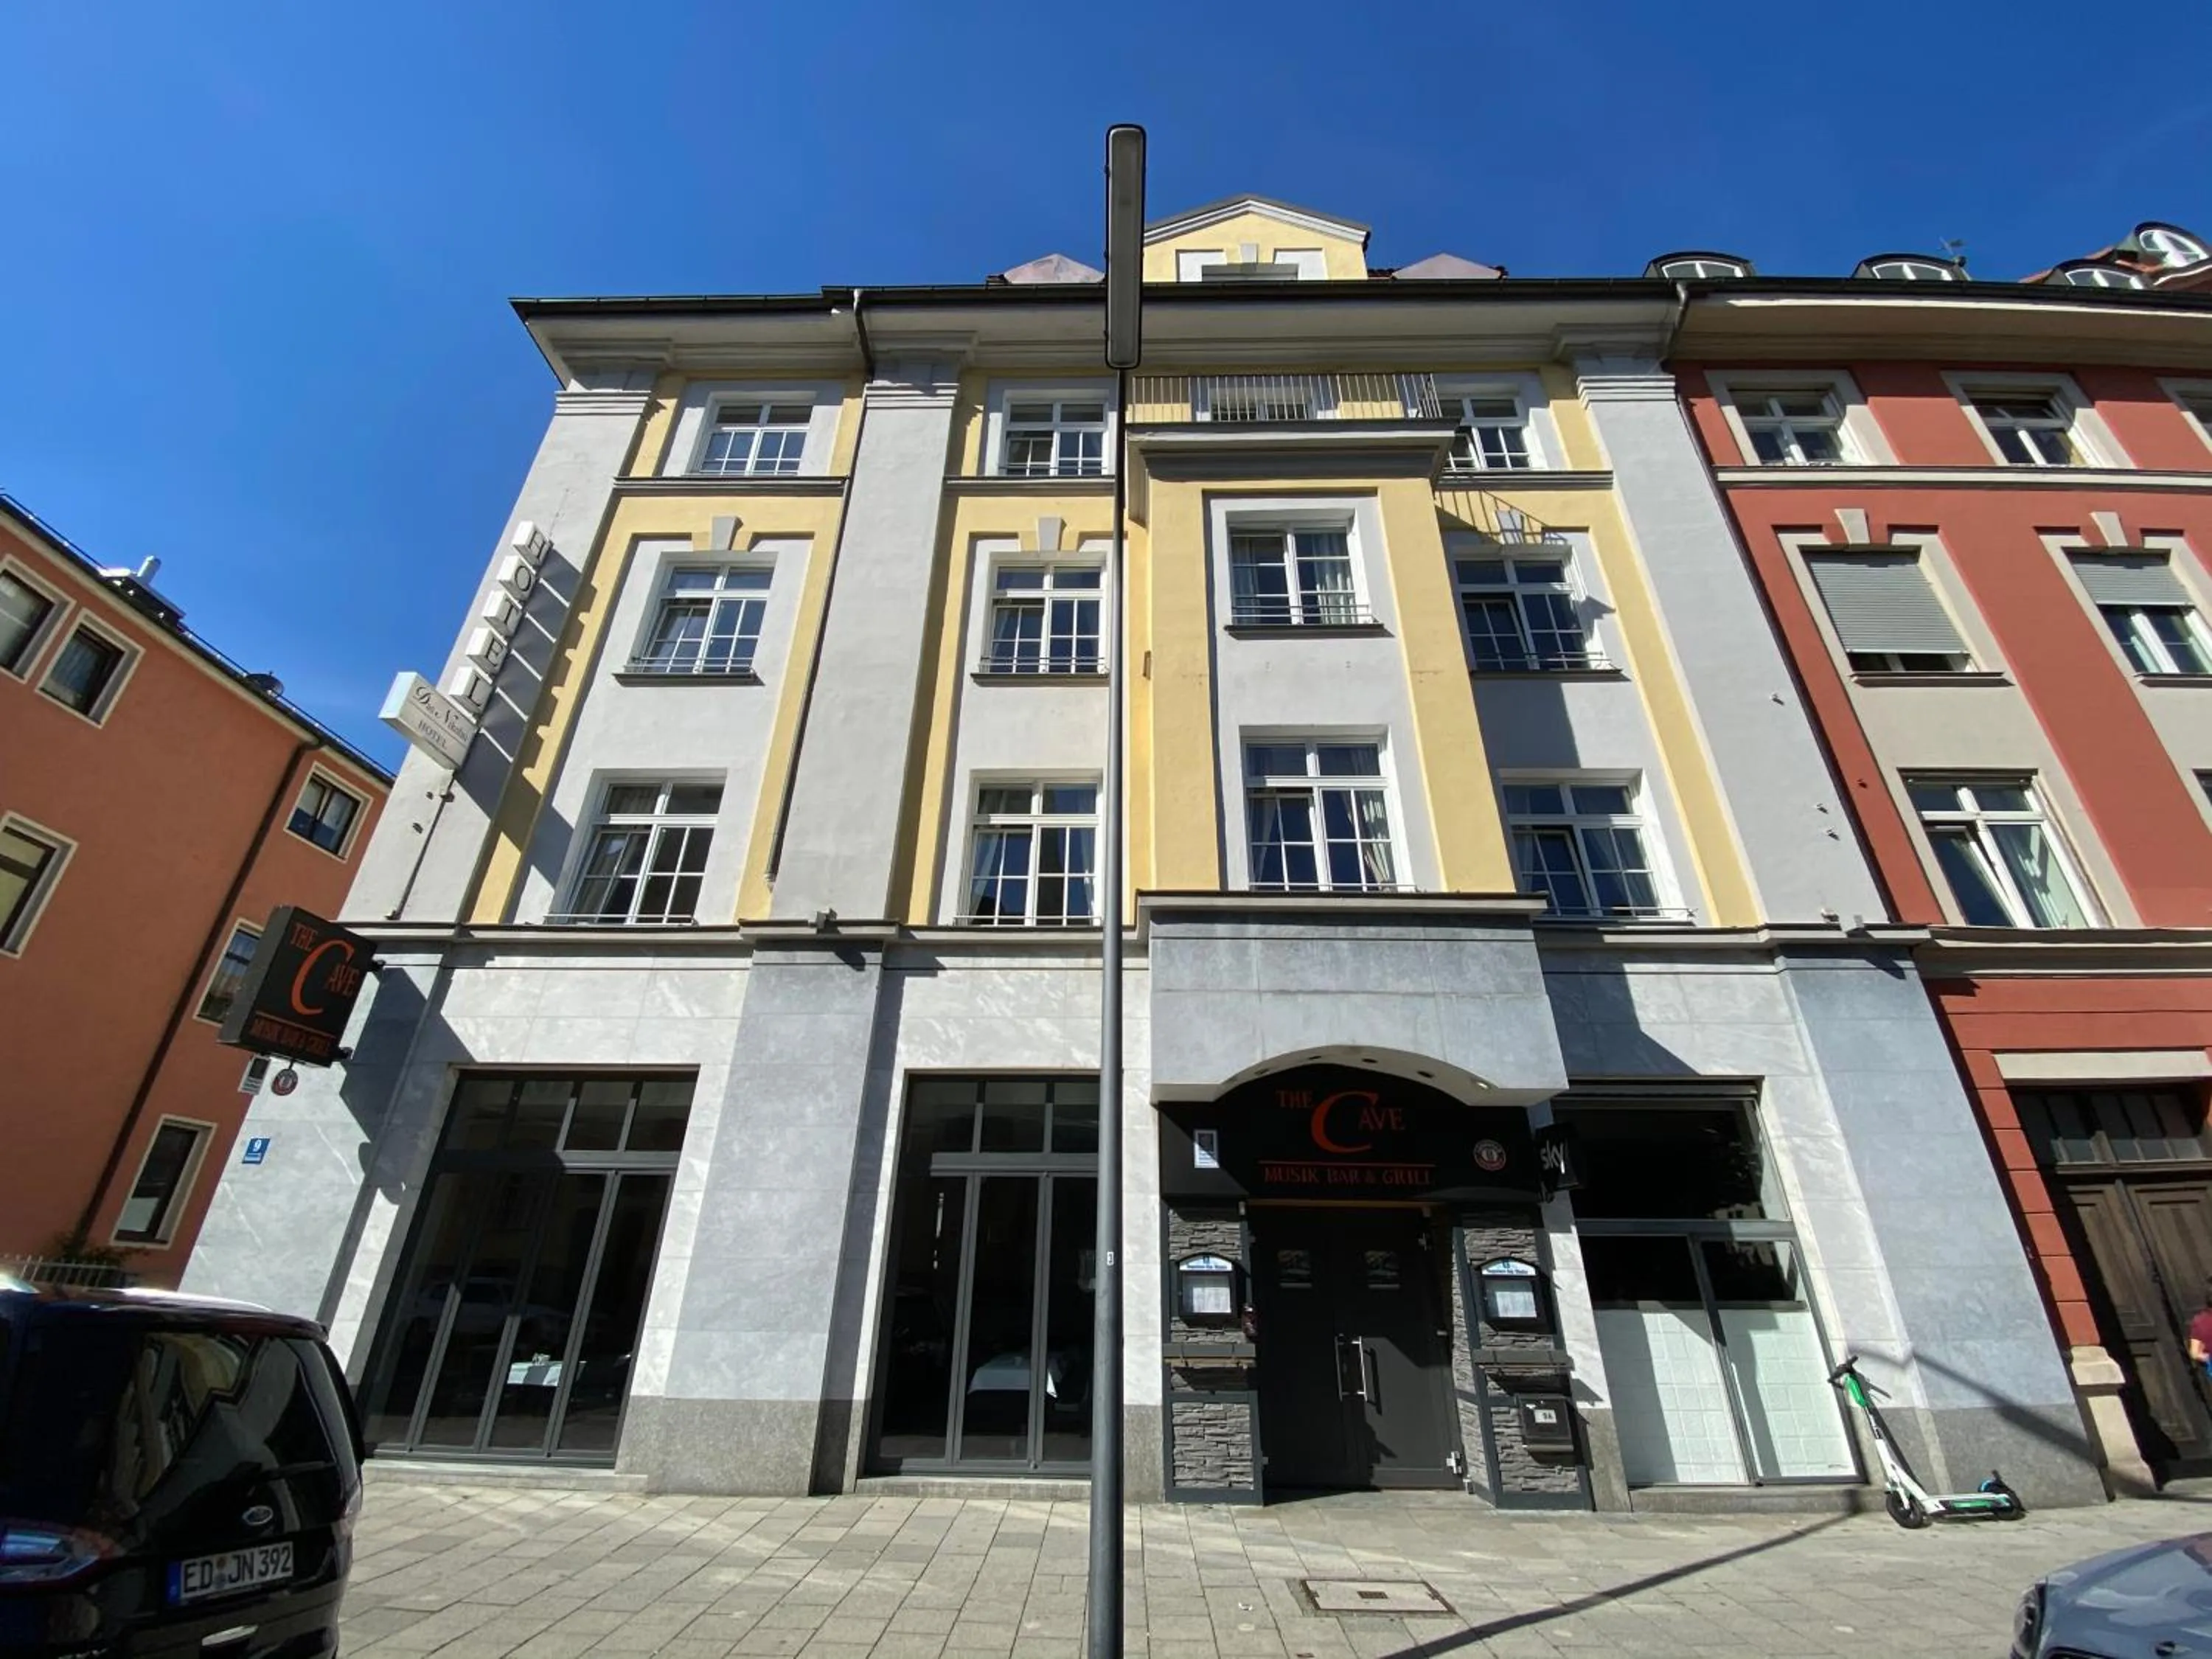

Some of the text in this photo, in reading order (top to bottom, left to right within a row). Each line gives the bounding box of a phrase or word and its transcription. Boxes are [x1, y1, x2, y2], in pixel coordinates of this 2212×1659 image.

[468, 529, 547, 707] HOTEL
[290, 922, 319, 952] THE
[291, 939, 360, 1015] CAVE
[1276, 1089, 1313, 1108] THE
[1311, 1091, 1406, 1153] CAVE
[253, 1139, 262, 1152] 9
[1540, 1140, 1565, 1175] sky
[1264, 1166, 1319, 1183] MUSIK
[1326, 1168, 1360, 1185] BAR
[1381, 1168, 1433, 1186] GRILL
[184, 1546, 291, 1593] ED JN 392
